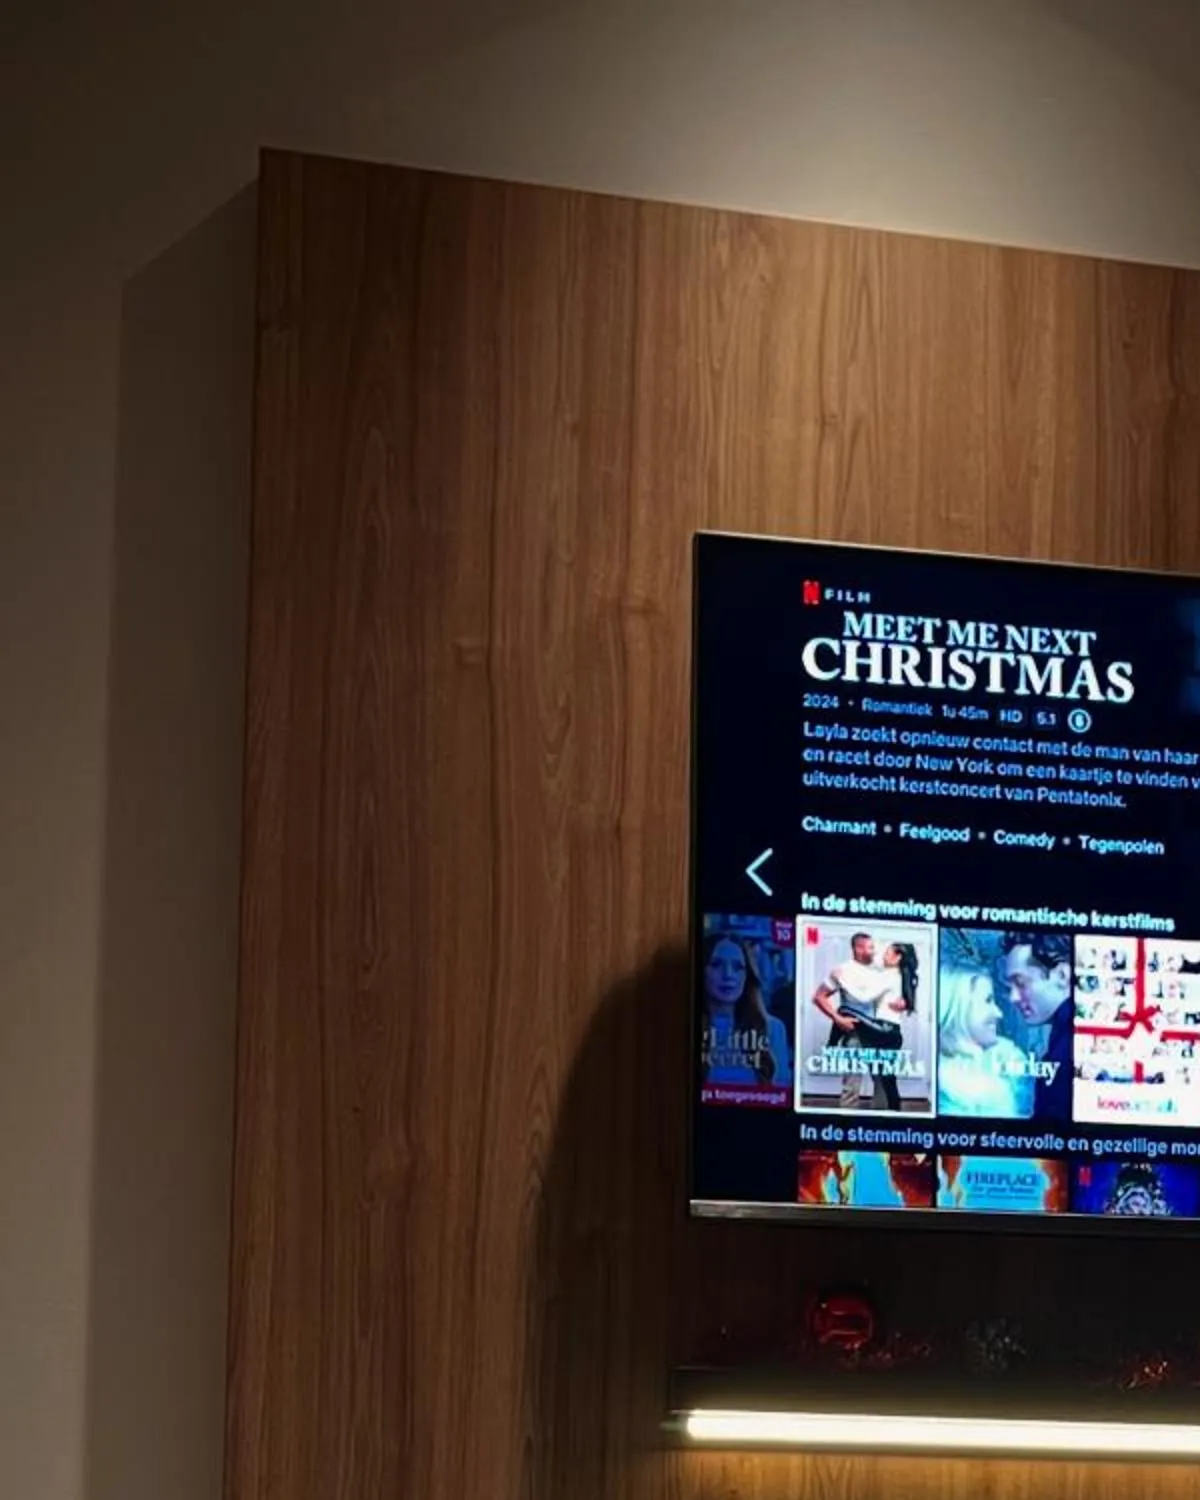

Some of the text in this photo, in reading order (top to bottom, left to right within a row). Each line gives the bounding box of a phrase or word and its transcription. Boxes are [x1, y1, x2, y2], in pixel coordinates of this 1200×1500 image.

[824, 588, 871, 604] FILM
[842, 611, 1098, 657] MEET ME NEXT
[802, 637, 1135, 704] CHRISTMAS
[803, 693, 839, 709] 2024
[862, 698, 933, 717] Romantiek
[1000, 709, 1023, 723] HD
[803, 721, 849, 742] Layla
[851, 724, 897, 744] zoekt
[900, 730, 970, 748] opnieuw
[972, 736, 1034, 753] contact
[1037, 741, 1068, 756] met
[1071, 741, 1092, 758] de
[1095, 746, 1130, 761] man
[1132, 749, 1161, 764] van
[1164, 747, 1199, 766] haar
[802, 748, 825, 762] en
[827, 750, 871, 766] racet
[873, 752, 912, 769] door
[915, 755, 954, 772] New
[956, 757, 995, 775] York
[996, 763, 1023, 777] om
[1026, 765, 1056, 780] een
[1059, 765, 1113, 786] kaartje
[1116, 770, 1133, 785] te
[1136, 770, 1189, 789] vinden
[802, 771, 1127, 808] uitverkocht kerstconcert van Pentatonix.
[802, 816, 1165, 855] Charmant Feelgood Comedy Tegenpolen
[801, 893, 1175, 933] In de stemming voor romantische kerstfilms
[800, 1124, 817, 1141] In
[821, 1124, 844, 1142] de
[847, 1126, 934, 1149] stemming
[937, 1132, 976, 1147] voor
[980, 1132, 1065, 1151] sfeervolle
[1067, 1137, 1088, 1152] en
[1092, 1137, 1168, 1157] gezellige
